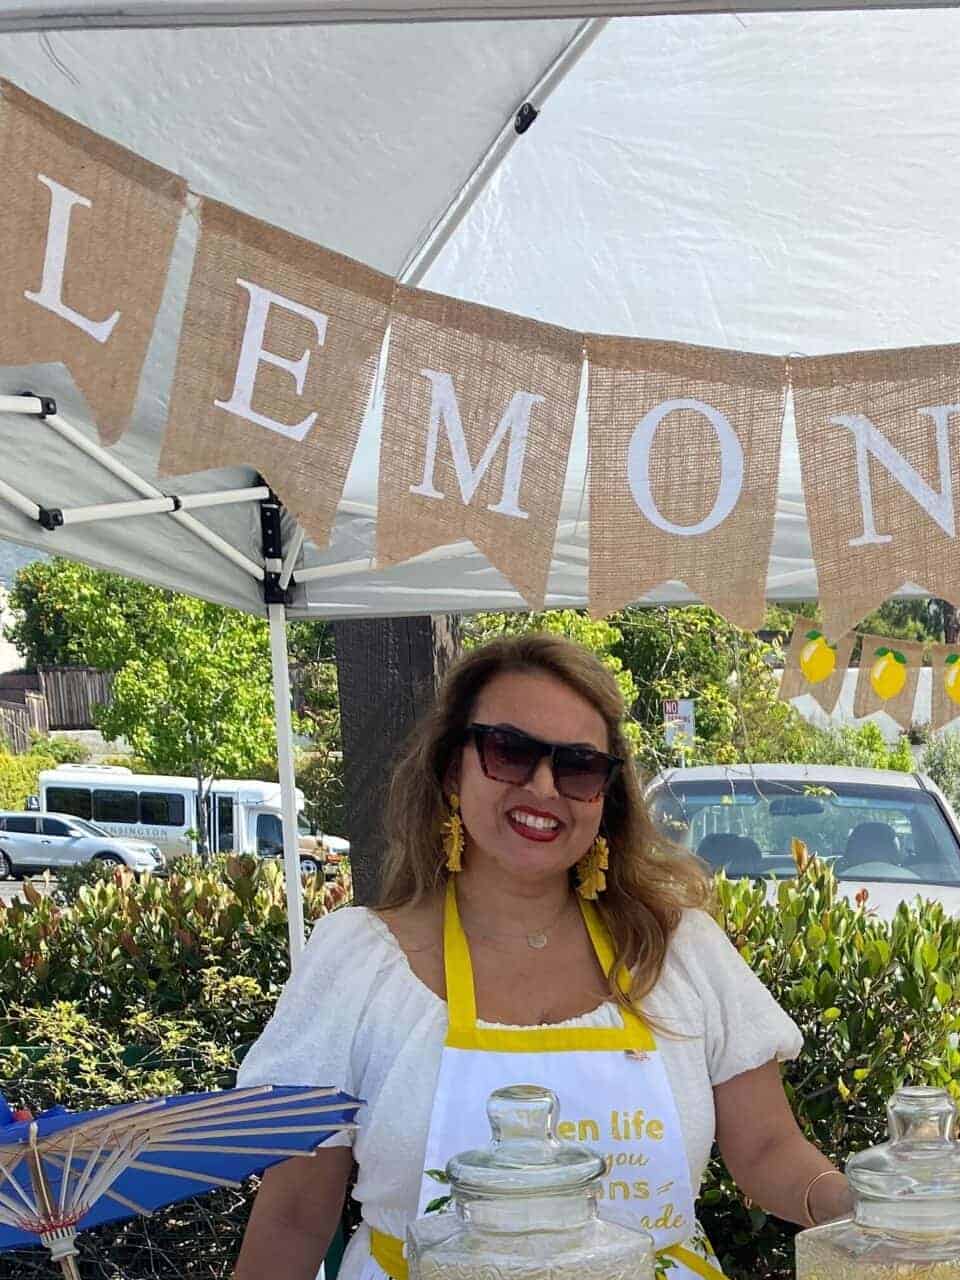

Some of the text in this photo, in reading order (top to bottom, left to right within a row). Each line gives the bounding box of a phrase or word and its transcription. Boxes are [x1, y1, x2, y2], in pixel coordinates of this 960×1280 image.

[665, 700, 678, 714] NO
[109, 824, 168, 838] NSINGTON
[556, 1109, 665, 1142] en life
[604, 1152, 649, 1177] you
